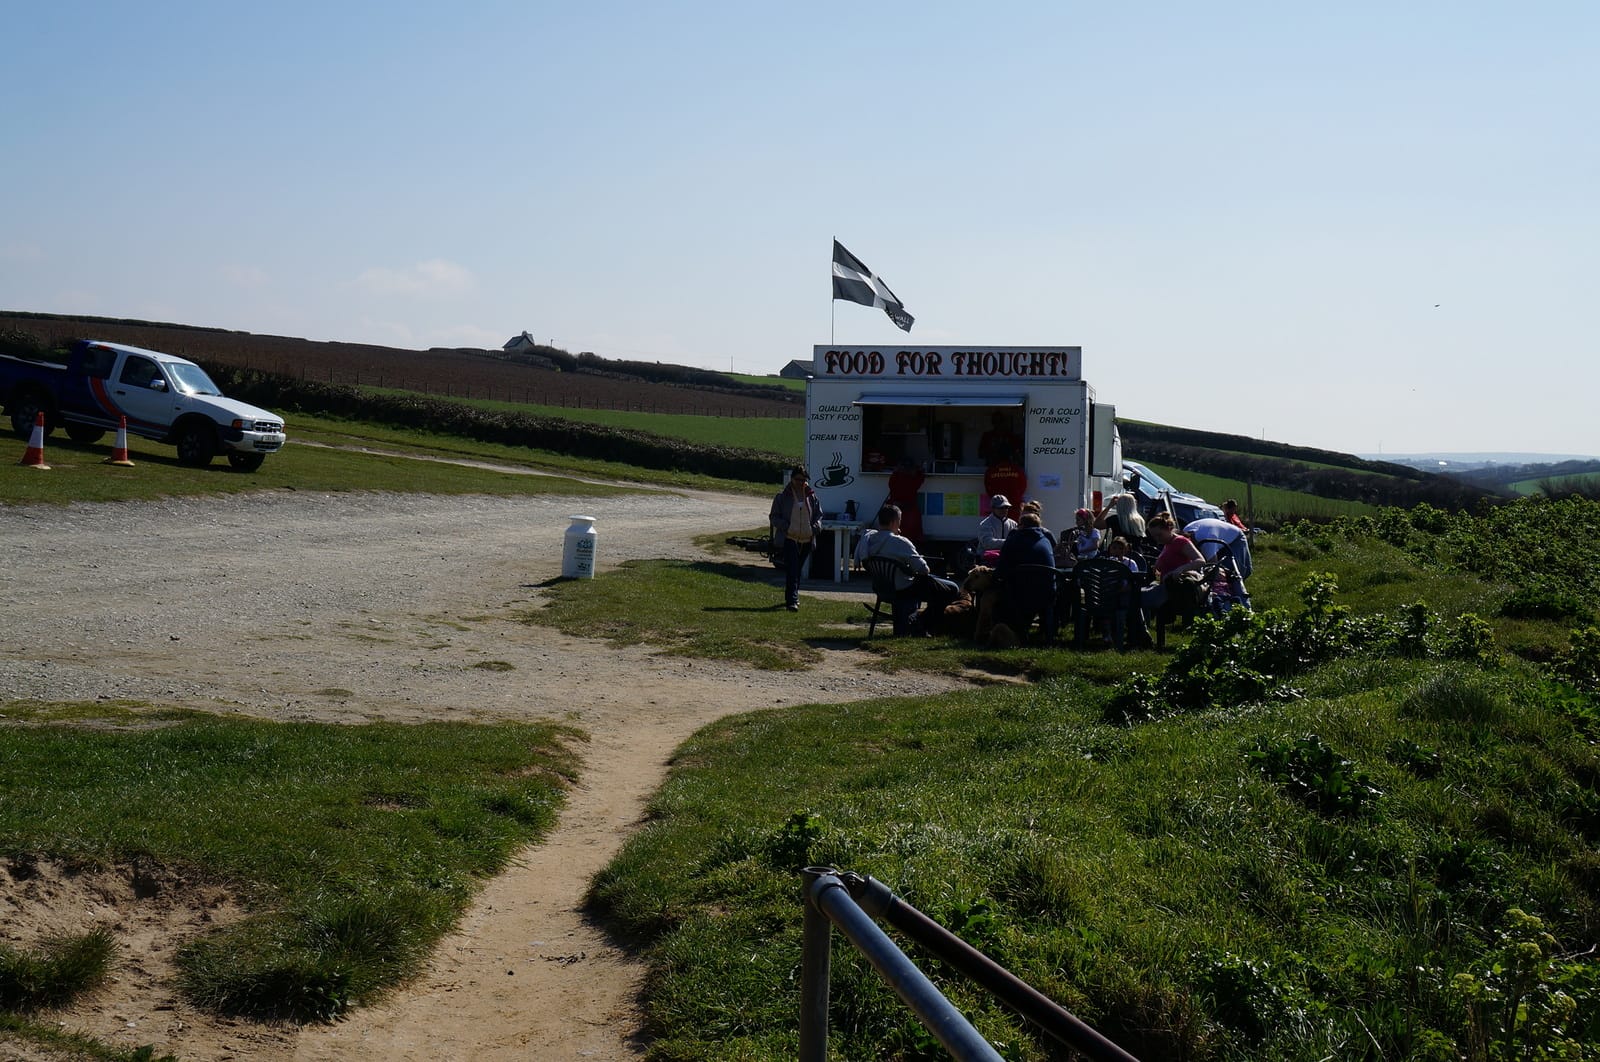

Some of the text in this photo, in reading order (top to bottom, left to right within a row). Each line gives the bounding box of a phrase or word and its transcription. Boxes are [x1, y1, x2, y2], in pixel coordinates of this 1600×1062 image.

[824, 350, 1068, 377] FOOD FOR THOUGHT!
[818, 404, 852, 413] QUALITY
[1029, 407, 1080, 416] HOT & COLD
[810, 413, 860, 421] TASTY FOOD
[1039, 416, 1071, 425] DRINKS
[809, 433, 860, 442] CREAM TEAS
[1042, 437, 1067, 446] DAILY
[1032, 447, 1076, 455] SPECIALS
